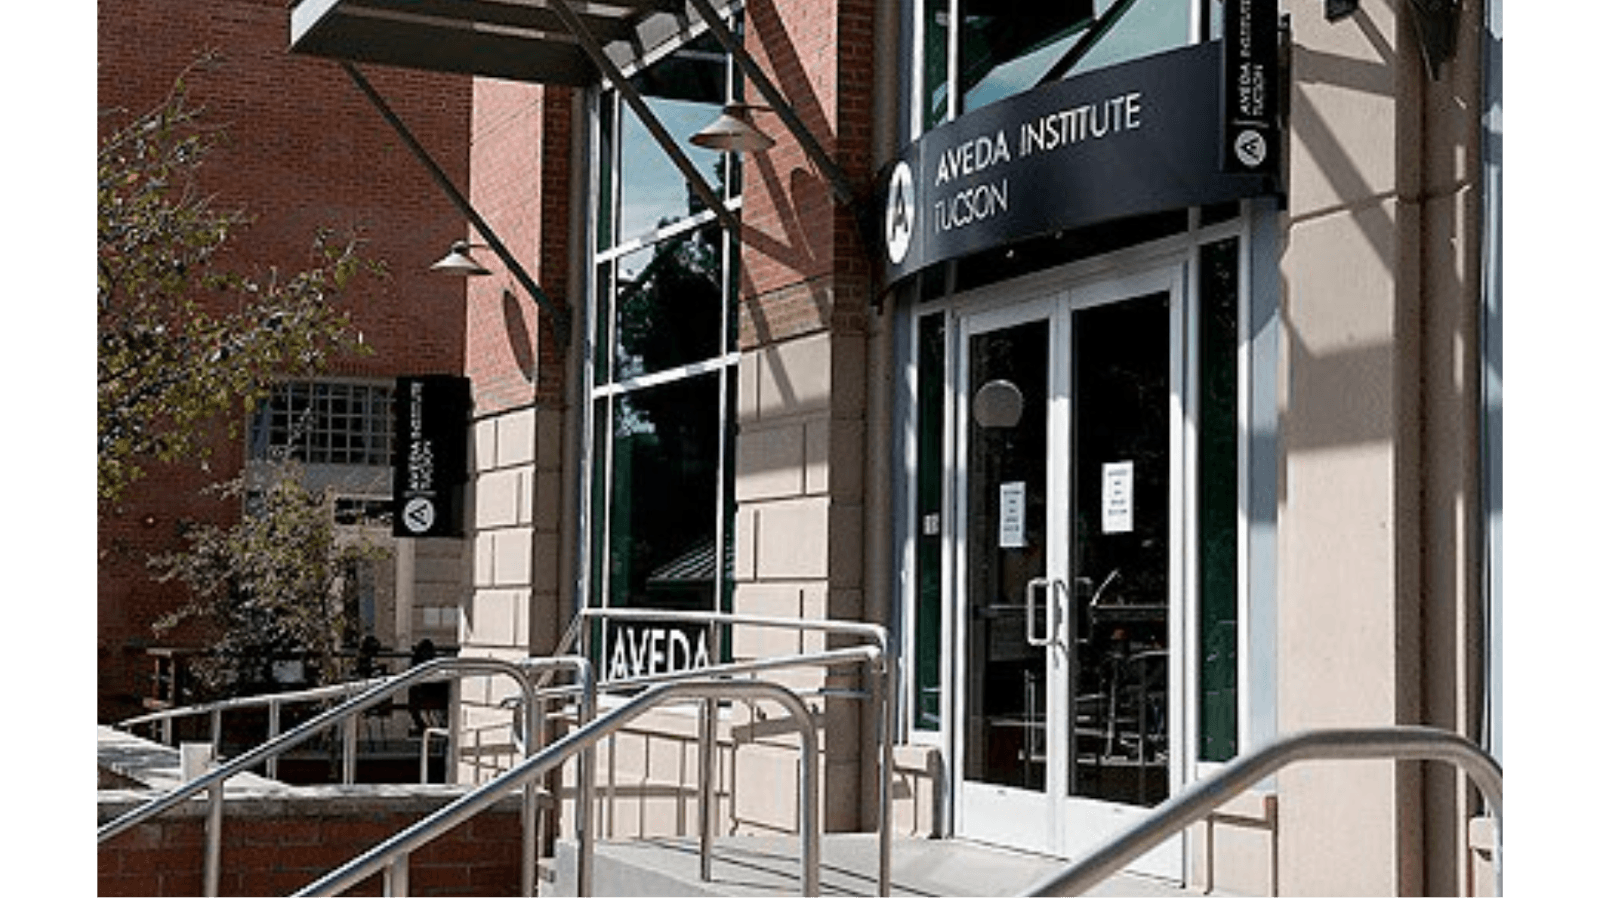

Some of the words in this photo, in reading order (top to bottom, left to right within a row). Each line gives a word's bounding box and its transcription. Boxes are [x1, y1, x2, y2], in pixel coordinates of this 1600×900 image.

[1239, 62, 1251, 116] AVEDA
[1252, 64, 1264, 116] TUCSON
[935, 129, 1011, 186] AVEDA
[1020, 93, 1142, 156] INSTITUTE
[935, 178, 1009, 233] TUCSON
[608, 626, 710, 682] AVEDA
